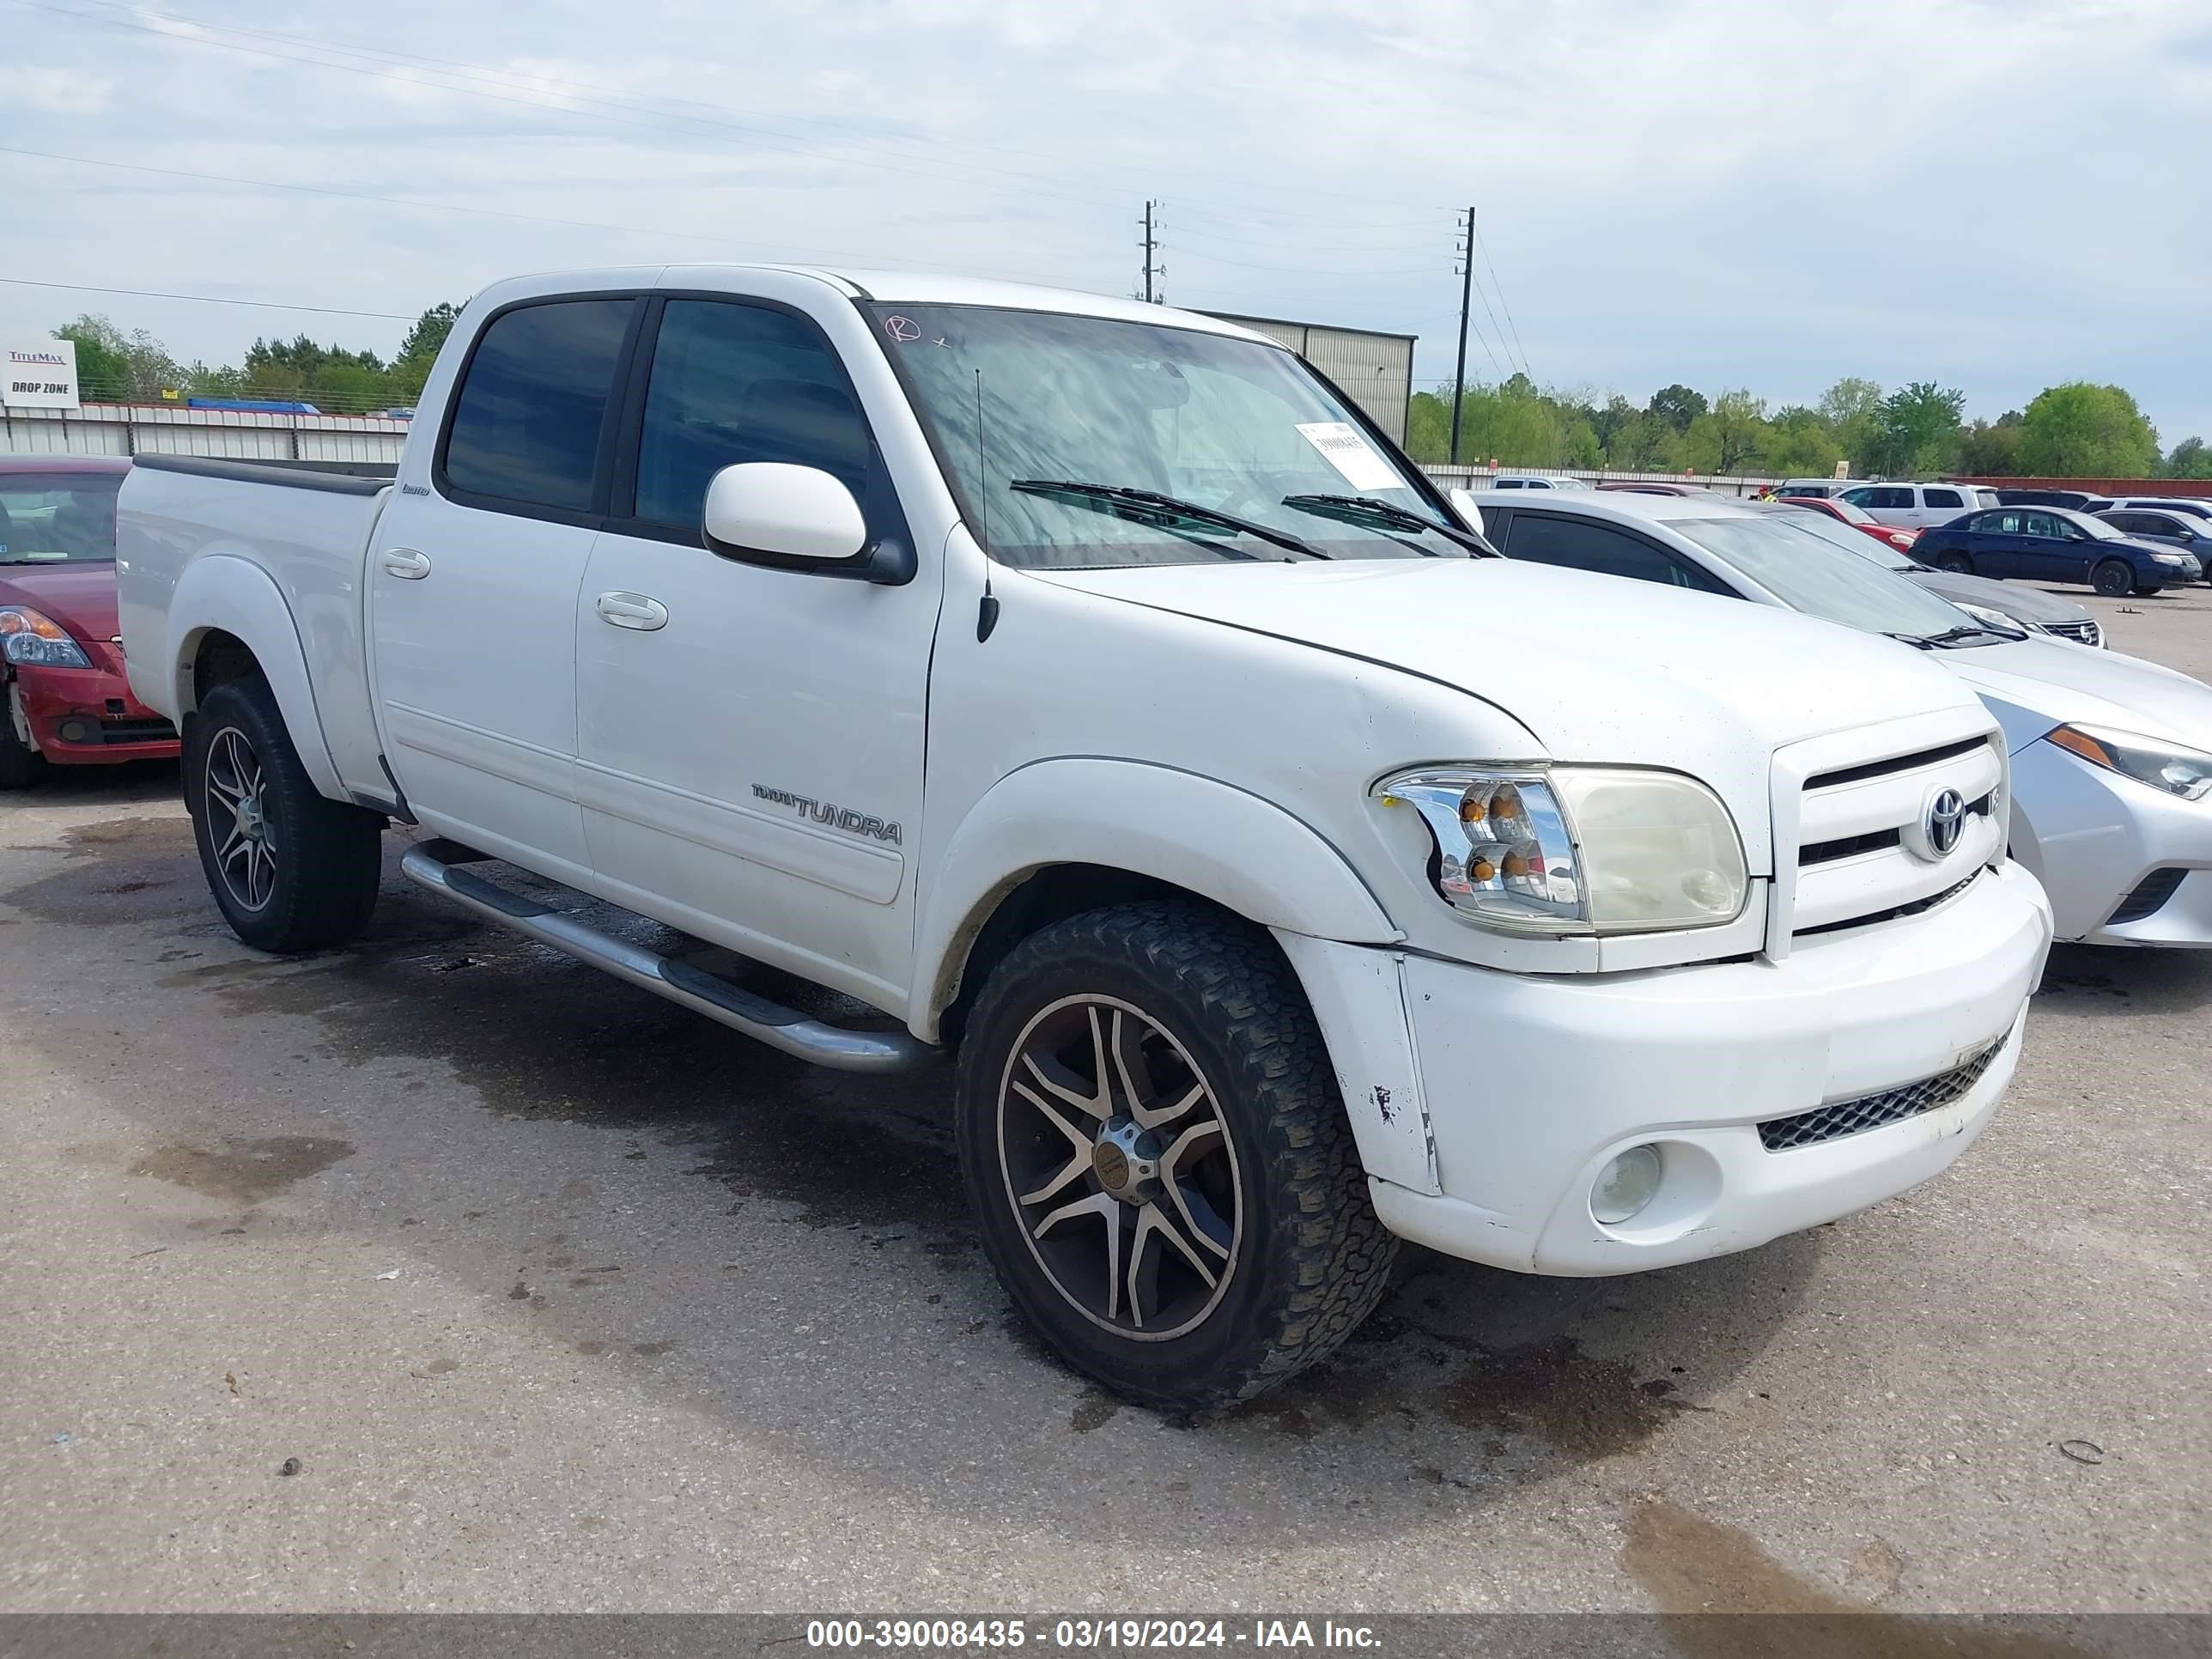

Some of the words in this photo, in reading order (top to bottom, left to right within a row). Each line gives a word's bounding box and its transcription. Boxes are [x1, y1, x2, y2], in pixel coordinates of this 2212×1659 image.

[12, 381, 41, 393] DROP
[43, 383, 70, 394] ZONE
[751, 782, 796, 808] TOYOTA
[794, 794, 902, 846] TUNDRA
